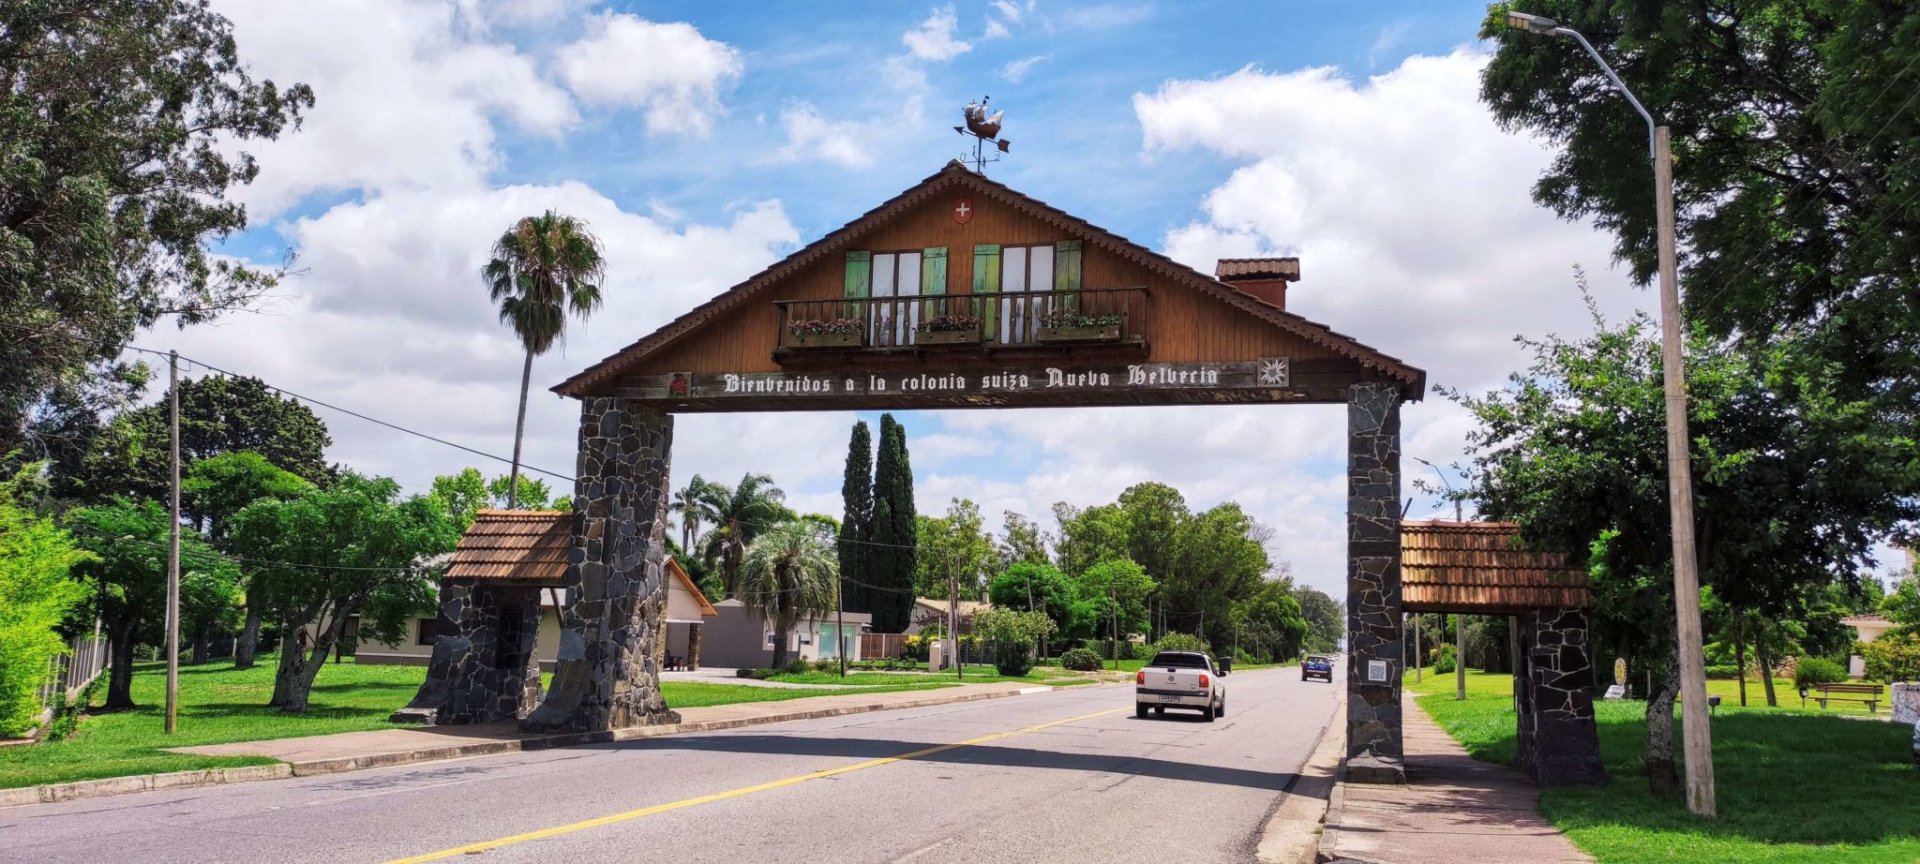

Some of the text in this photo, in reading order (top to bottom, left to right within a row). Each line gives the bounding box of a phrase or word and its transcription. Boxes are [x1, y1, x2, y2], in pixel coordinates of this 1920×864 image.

[724, 364, 1218, 393] Bienvenidos a la colonia suiza Nueva Helvecia
